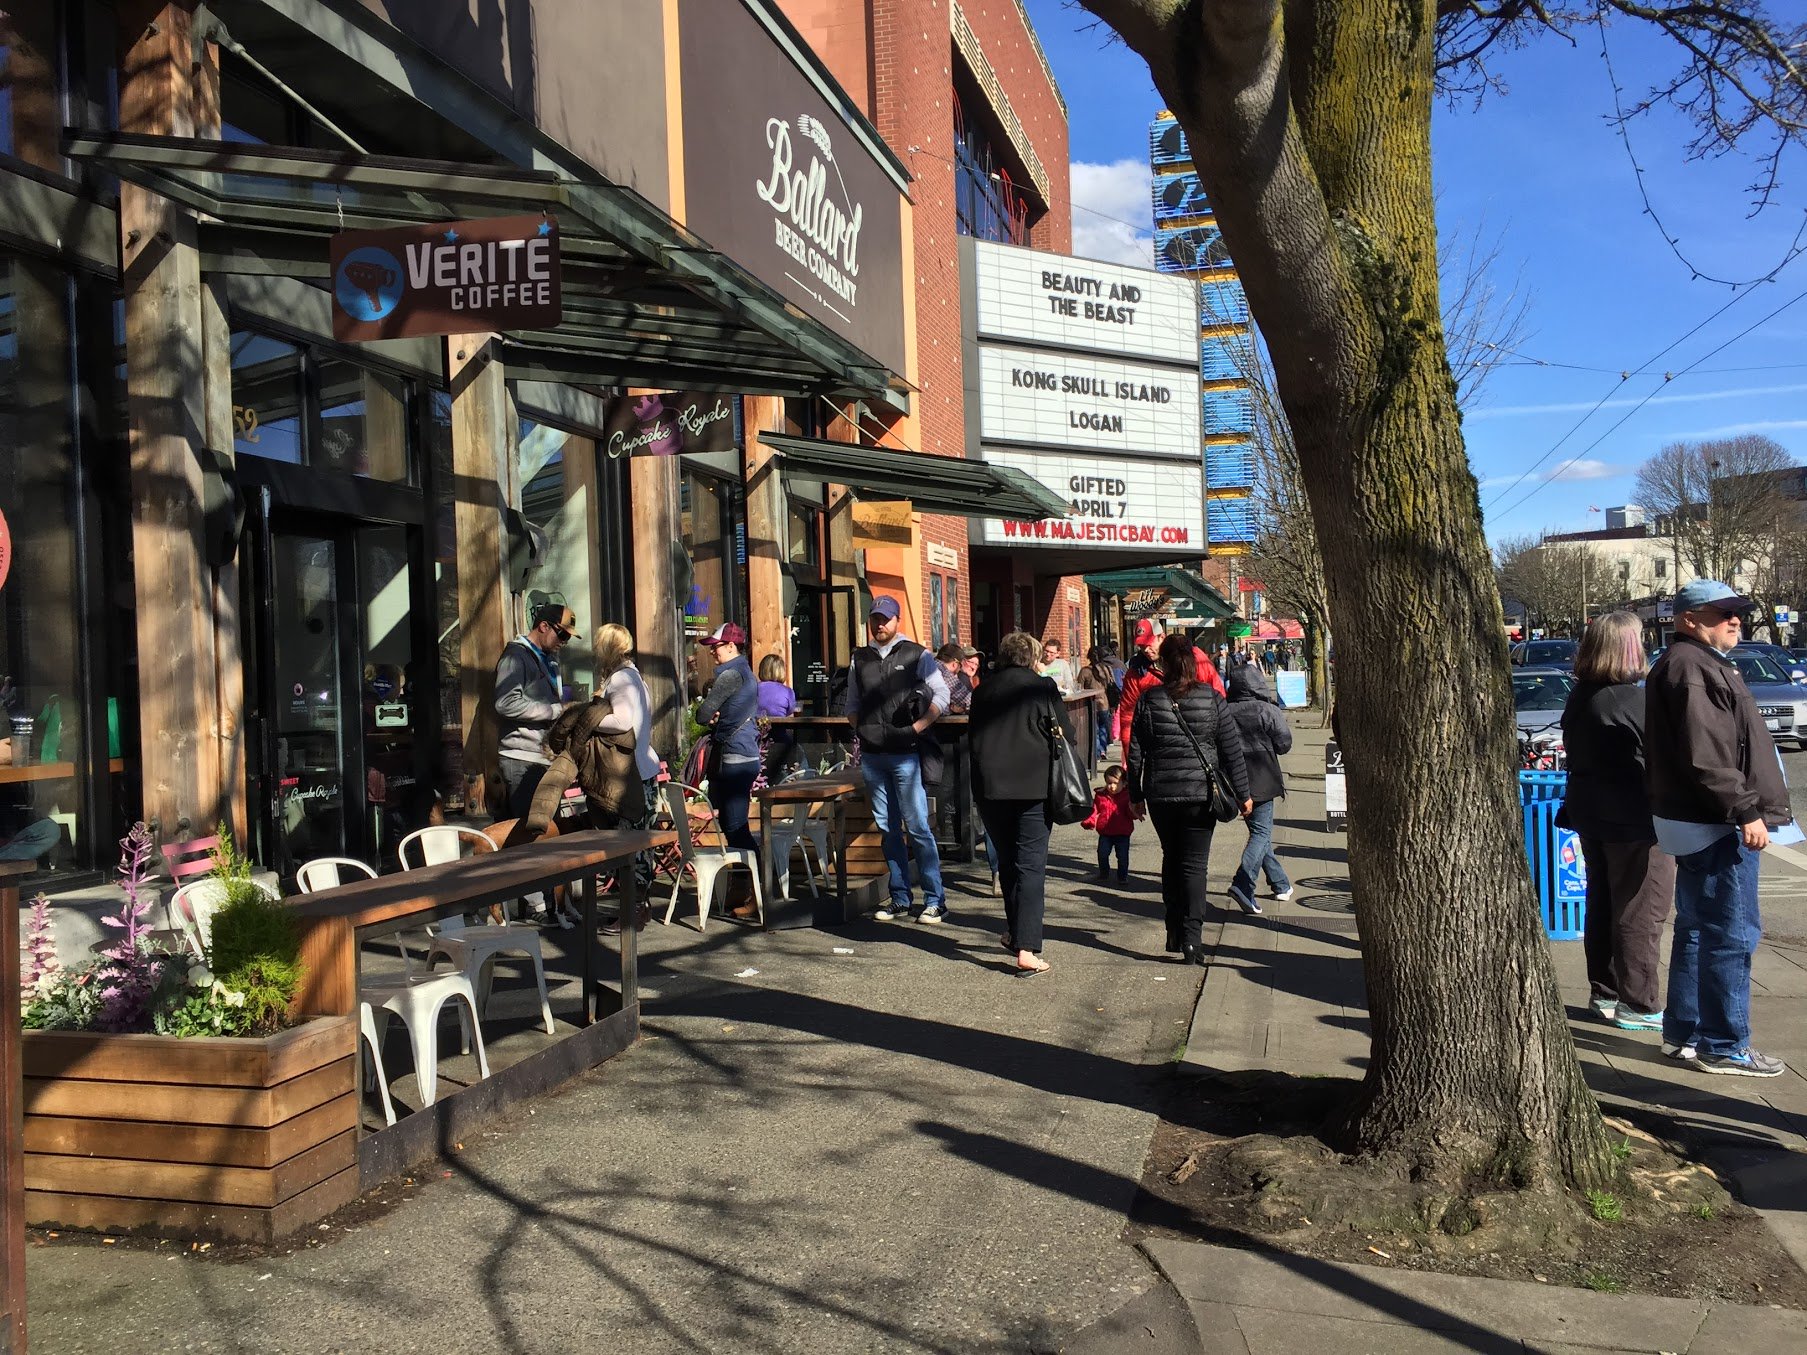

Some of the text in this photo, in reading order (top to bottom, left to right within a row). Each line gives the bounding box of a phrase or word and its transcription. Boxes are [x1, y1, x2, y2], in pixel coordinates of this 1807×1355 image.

[756, 117, 863, 277] Ballard
[774, 217, 857, 307] BEER COMPANY
[451, 281, 550, 310] COFFEE
[1041, 271, 1142, 304] BEAUTY AND
[1048, 295, 1136, 326] THE BEAST
[1012, 368, 1171, 404] KONG SKULL ISLAND
[607, 399, 730, 459] Cupcake Royale
[1070, 410, 1123, 433] LOGAN
[1069, 475, 1126, 496] GIFTED
[1069, 499, 1127, 519] APRIL 7
[280, 777, 300, 786] SWEET
[290, 786, 316, 803] Cupcake
